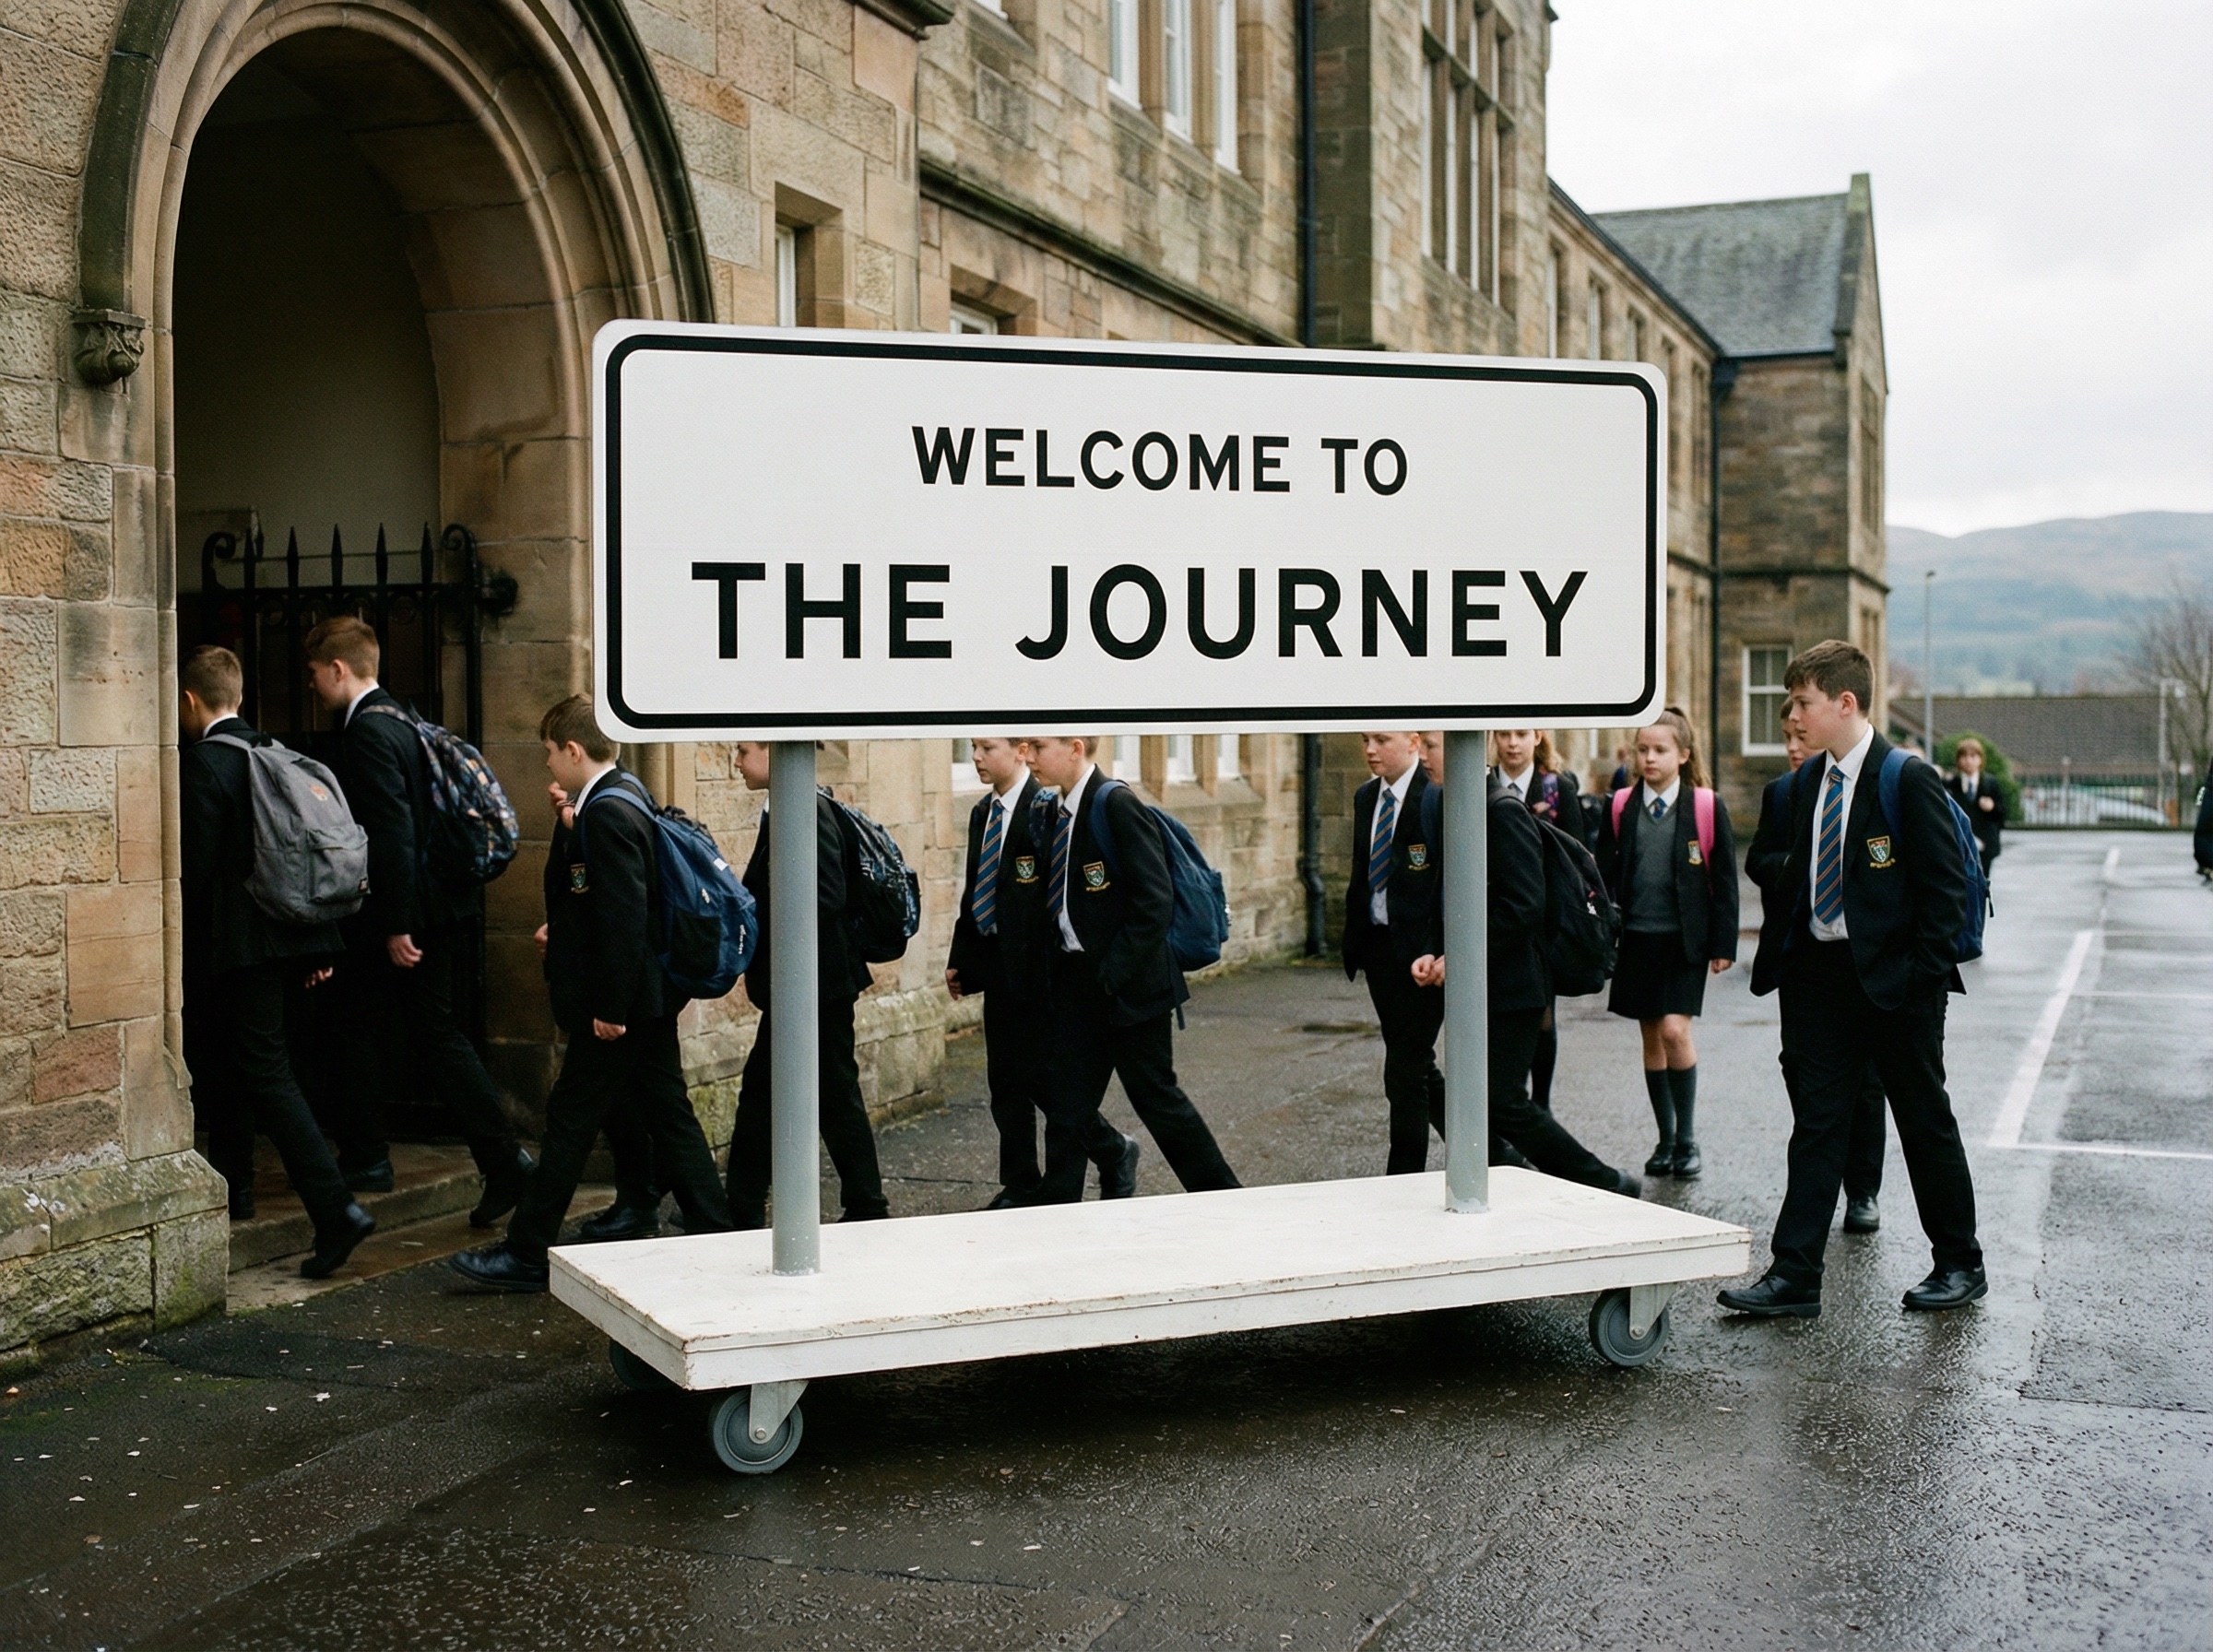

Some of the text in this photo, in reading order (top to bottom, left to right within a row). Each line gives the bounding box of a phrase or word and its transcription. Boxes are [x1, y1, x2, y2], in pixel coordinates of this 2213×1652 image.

[911, 426, 1408, 496] WELCOME TO
[691, 561, 1589, 662] THE JOURNEY
